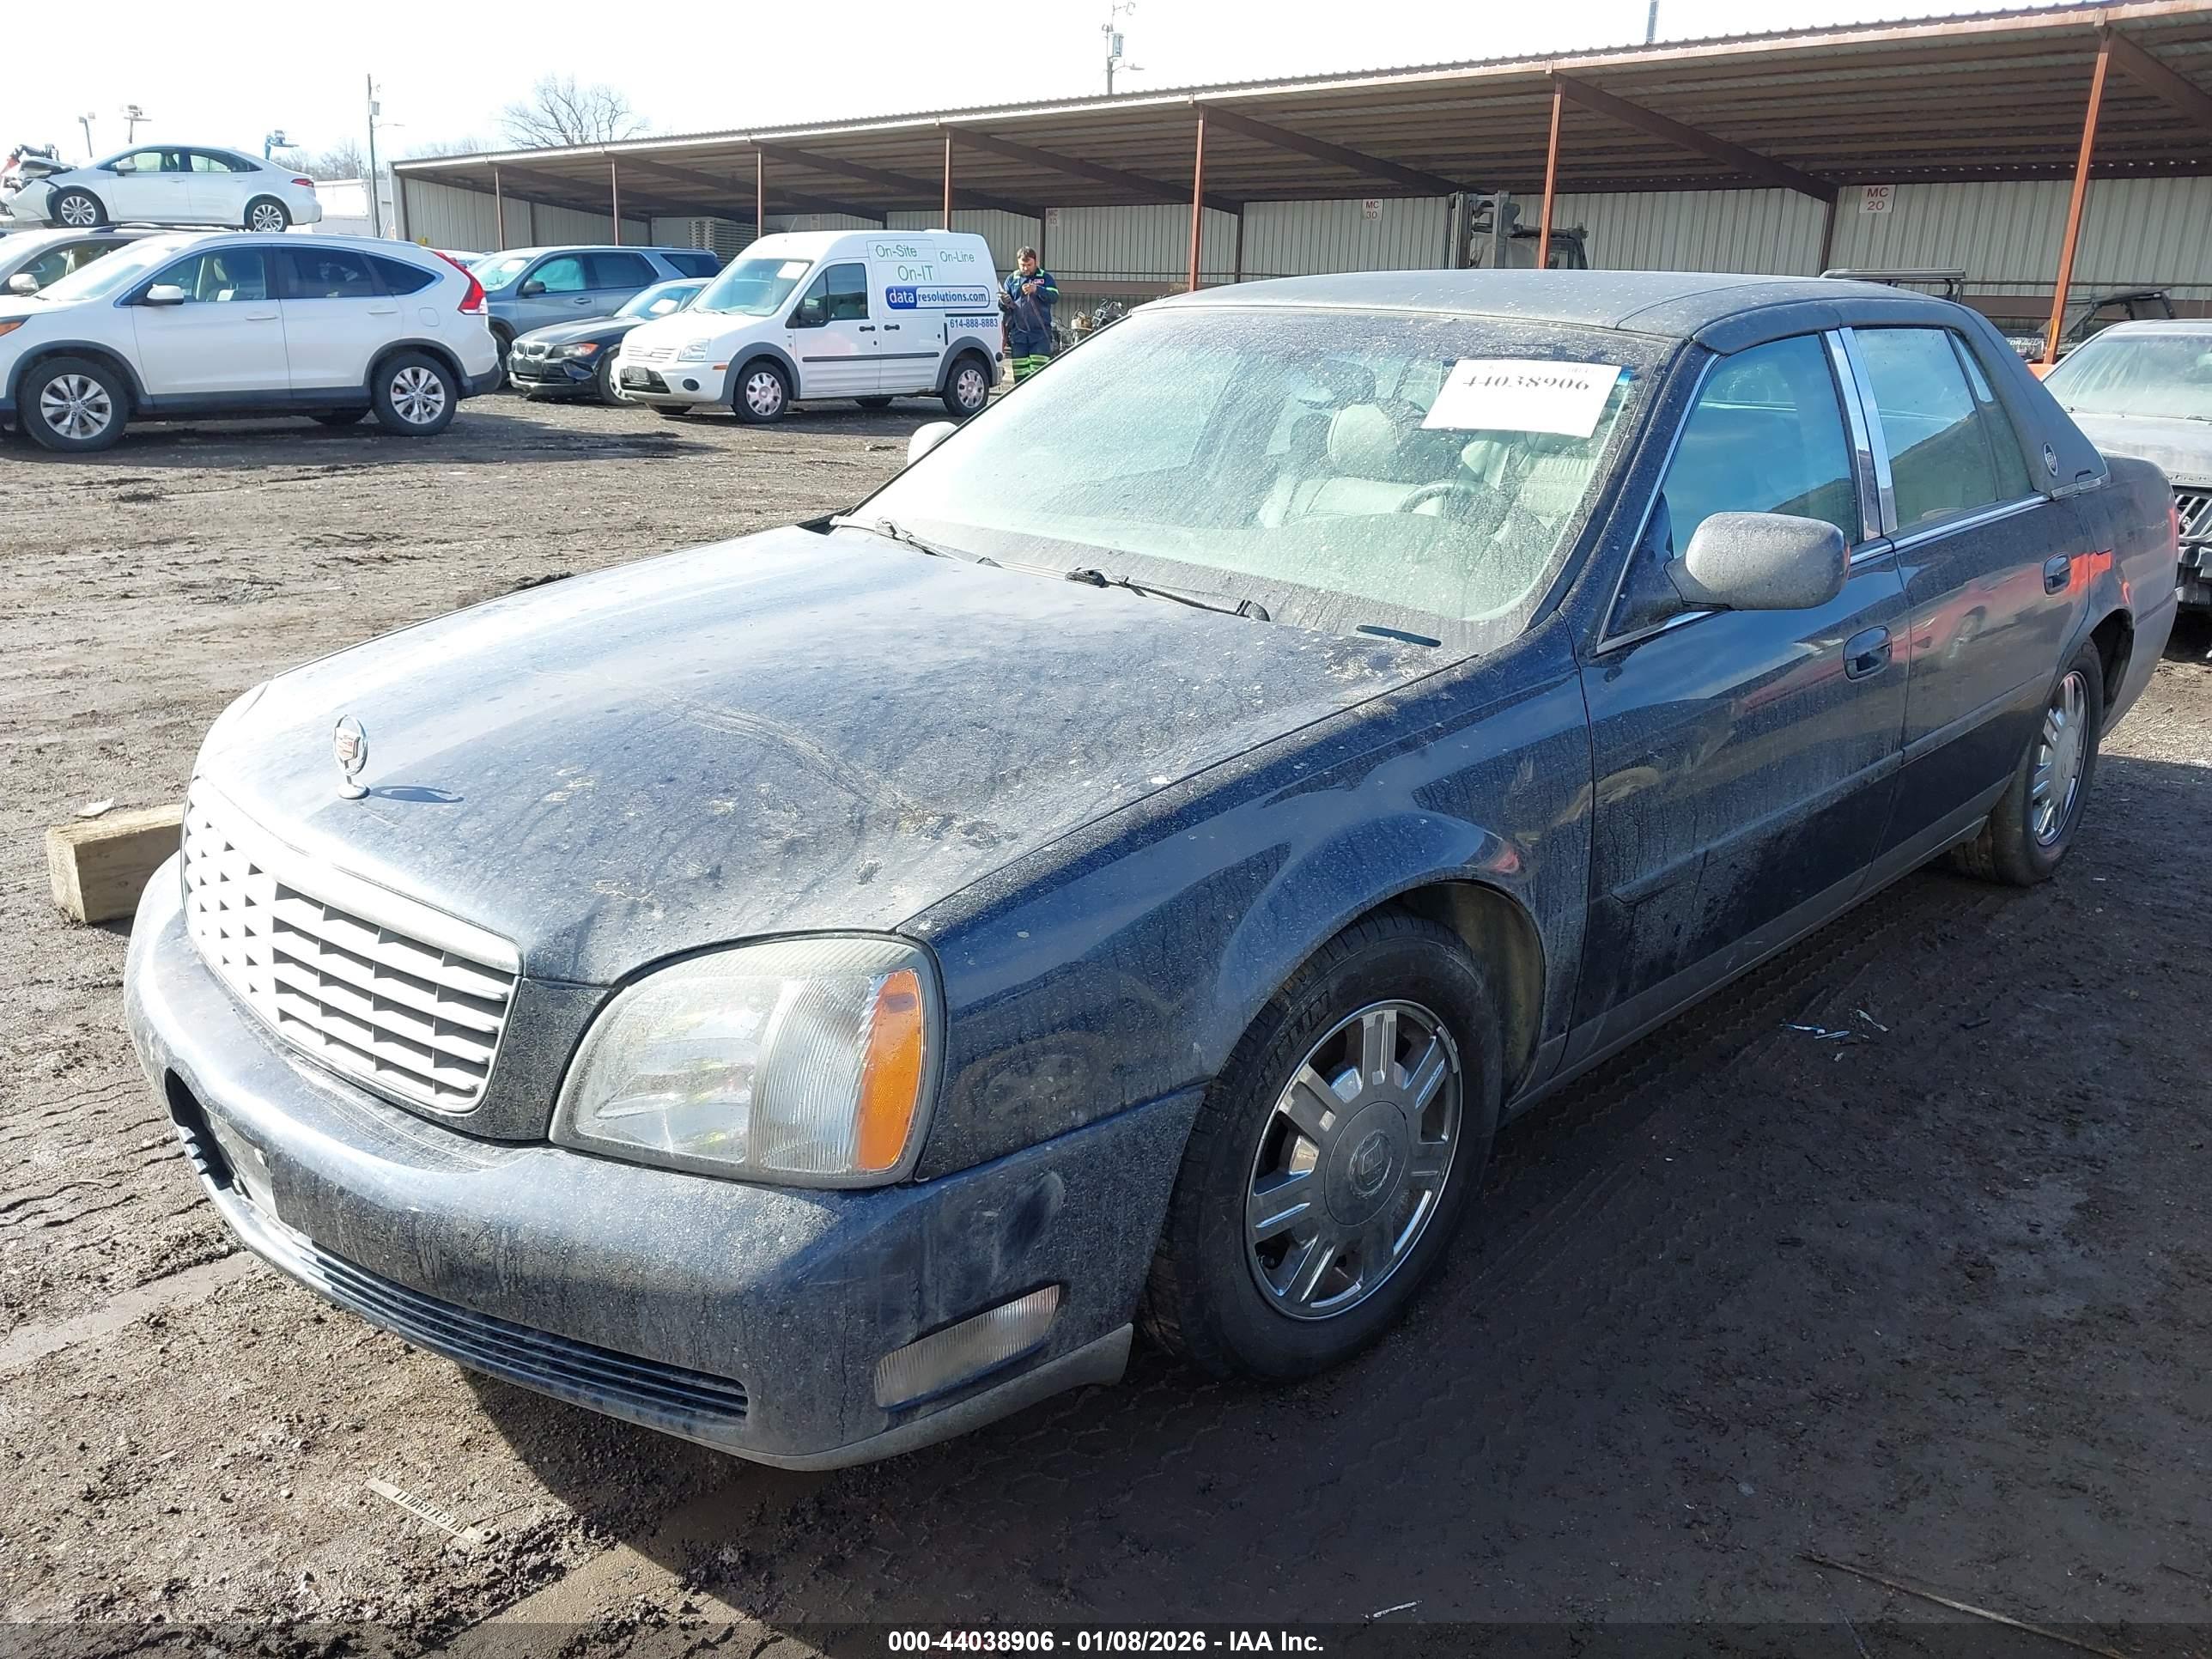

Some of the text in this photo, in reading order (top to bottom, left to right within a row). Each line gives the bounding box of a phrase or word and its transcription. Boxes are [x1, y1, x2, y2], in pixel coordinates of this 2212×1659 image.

[1867, 186, 1890, 198] MC
[1867, 200, 1885, 211] 20
[875, 244, 918, 258] On-Site
[939, 251, 975, 263] On-Line
[897, 264, 933, 282] On-IT
